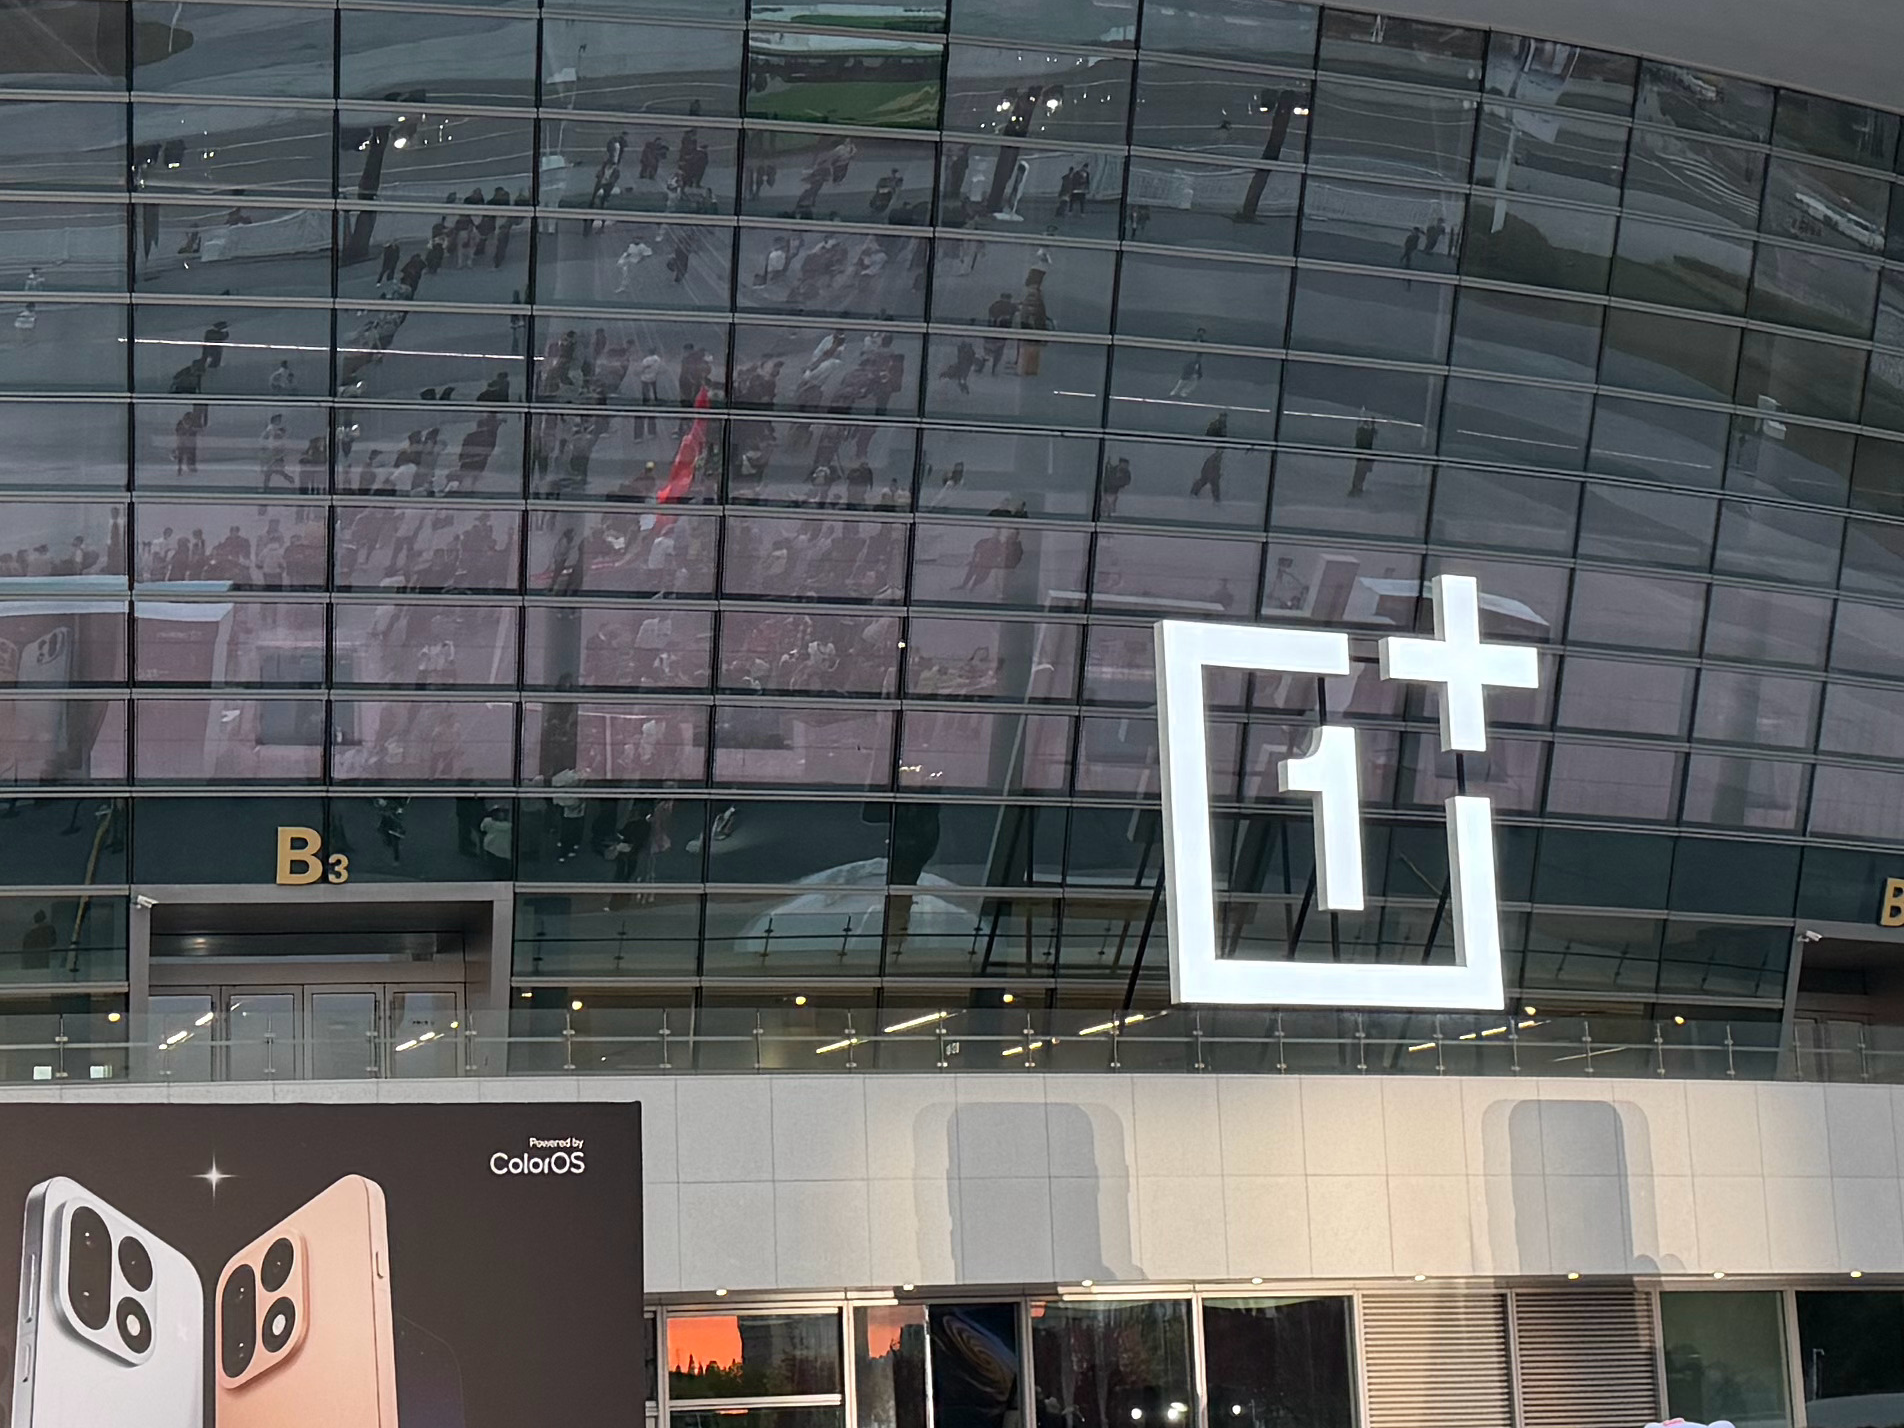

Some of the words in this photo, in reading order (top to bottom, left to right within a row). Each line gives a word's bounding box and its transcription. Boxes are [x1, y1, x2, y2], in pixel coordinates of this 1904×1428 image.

[276, 826, 349, 885] B3
[529, 1137, 571, 1148] Powered
[571, 1137, 584, 1149] by
[489, 1151, 586, 1175] ColorOS
